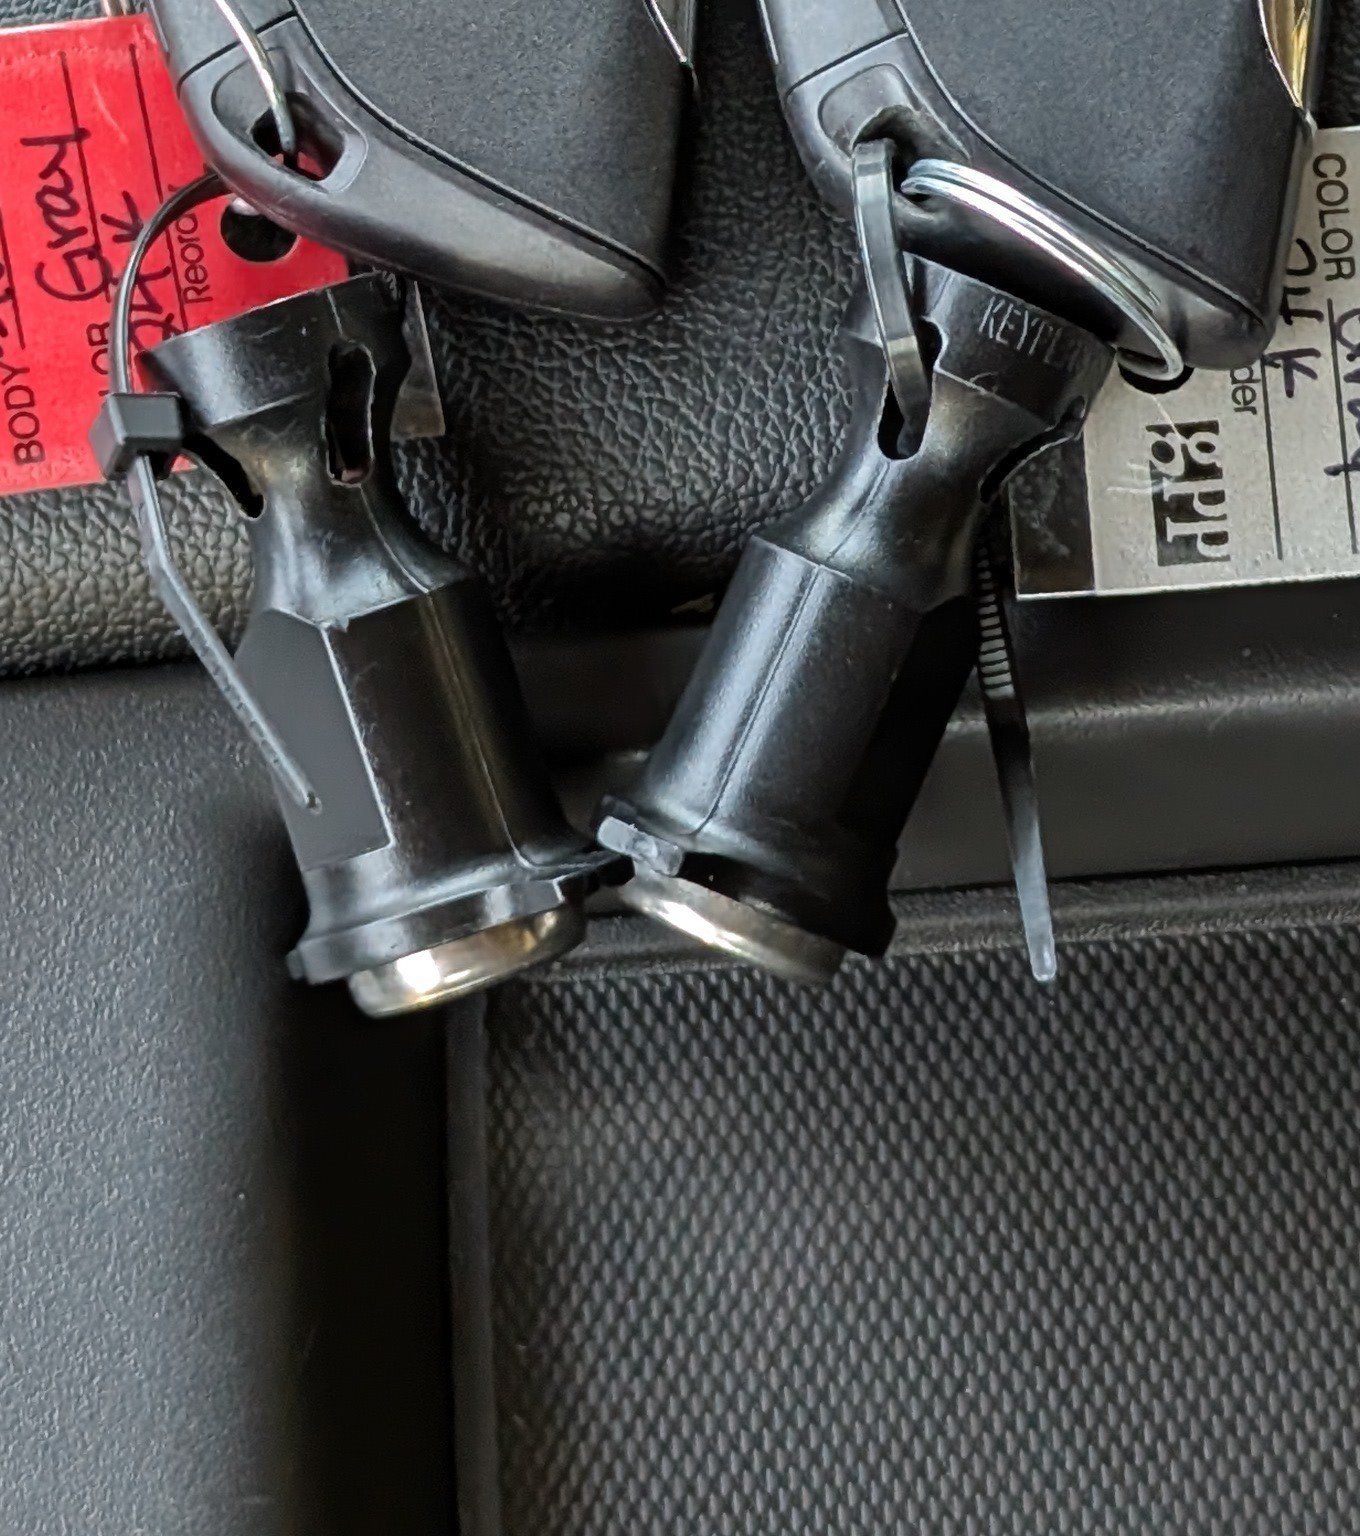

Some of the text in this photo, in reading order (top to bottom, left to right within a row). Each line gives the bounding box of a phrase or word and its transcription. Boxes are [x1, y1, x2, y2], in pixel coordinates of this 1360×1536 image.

[21, 126, 113, 304] Gray
[1311, 152, 1356, 282] COLOR
[4, 358, 46, 467] BODY
